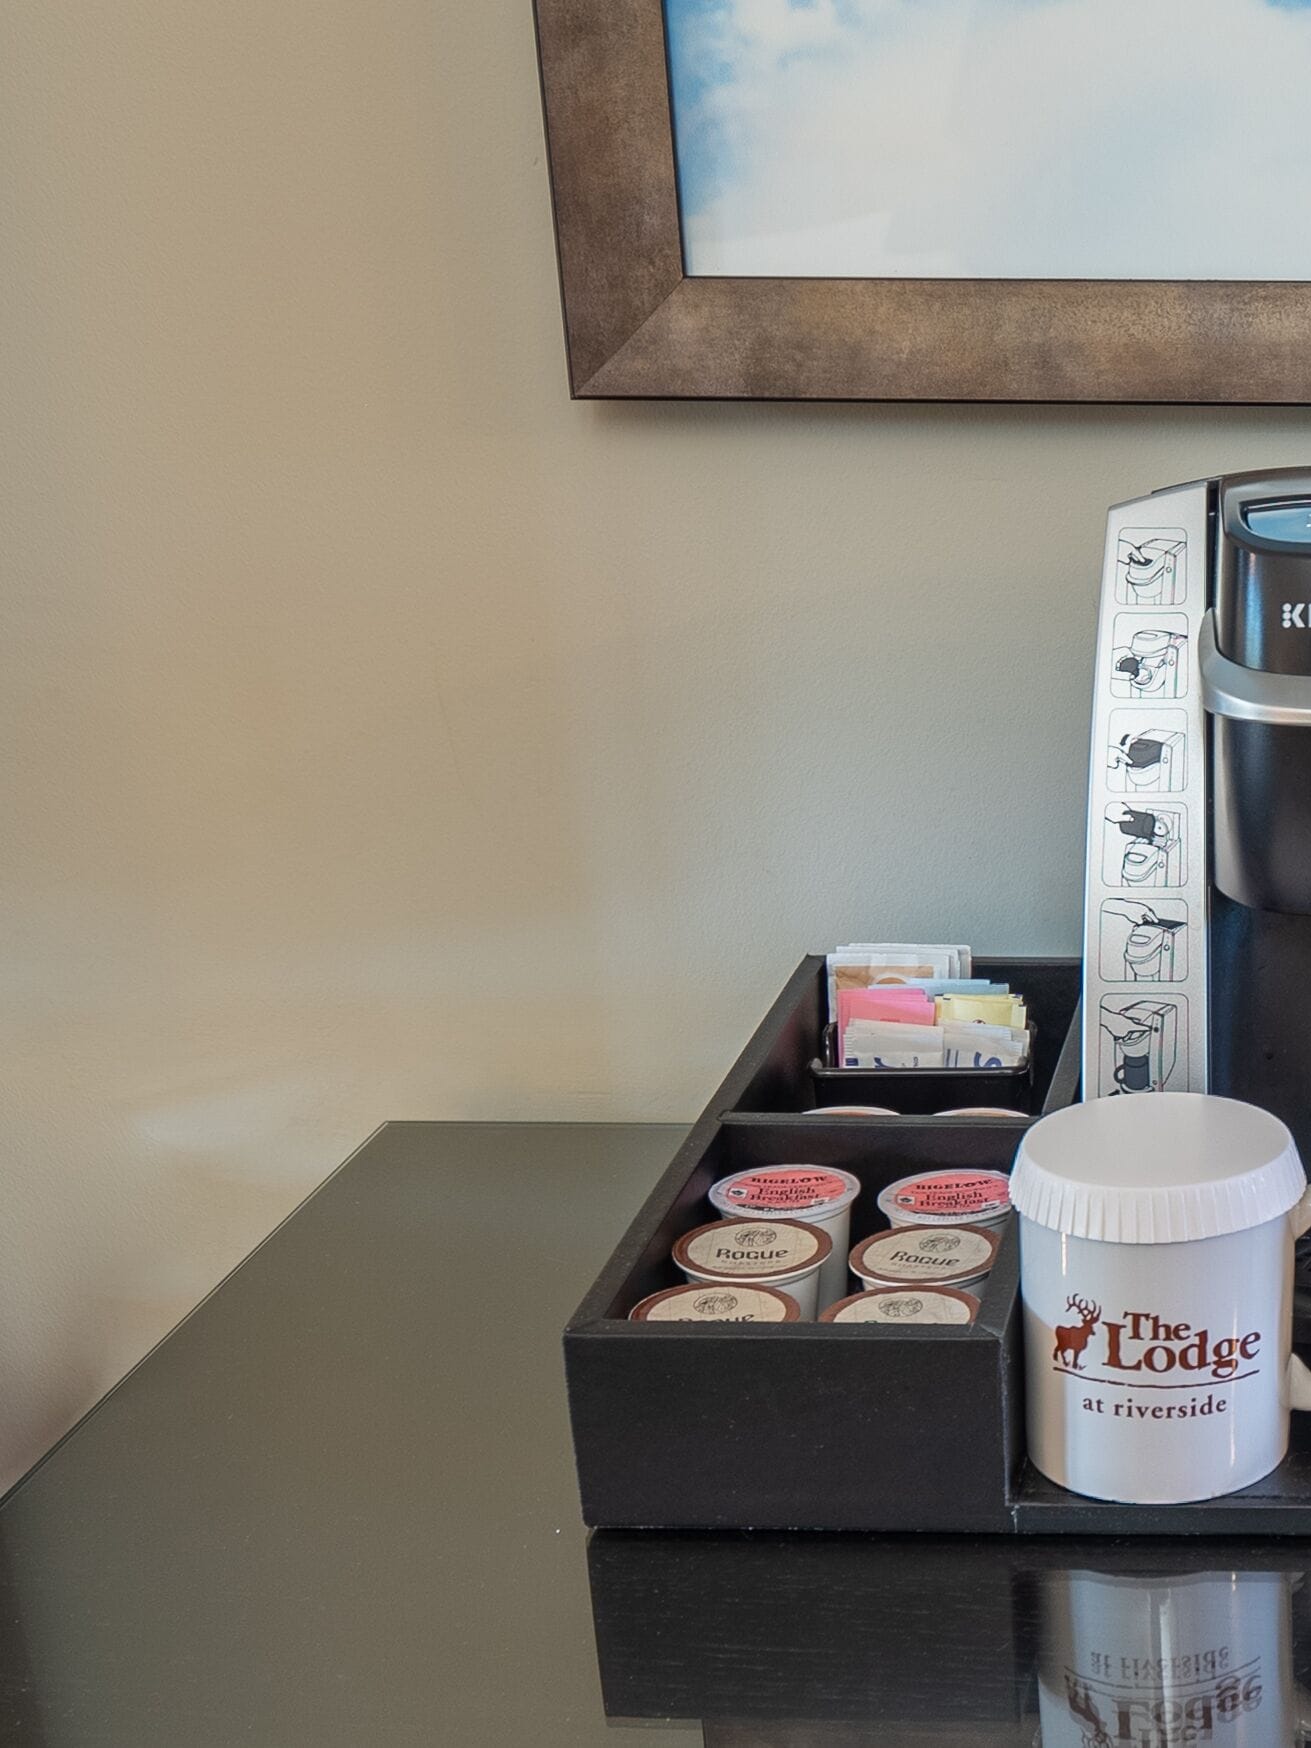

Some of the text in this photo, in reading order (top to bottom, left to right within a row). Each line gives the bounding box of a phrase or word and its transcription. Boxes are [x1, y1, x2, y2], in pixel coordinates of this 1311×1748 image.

[751, 1175, 828, 1185] BIGELOW
[749, 1193, 821, 1202] Breakfast
[758, 1186, 816, 1197] English
[925, 1191, 983, 1203] English
[1122, 1310, 1192, 1342] The
[1101, 1320, 1262, 1380] Lodge
[1082, 1394, 1228, 1420] at riverside
